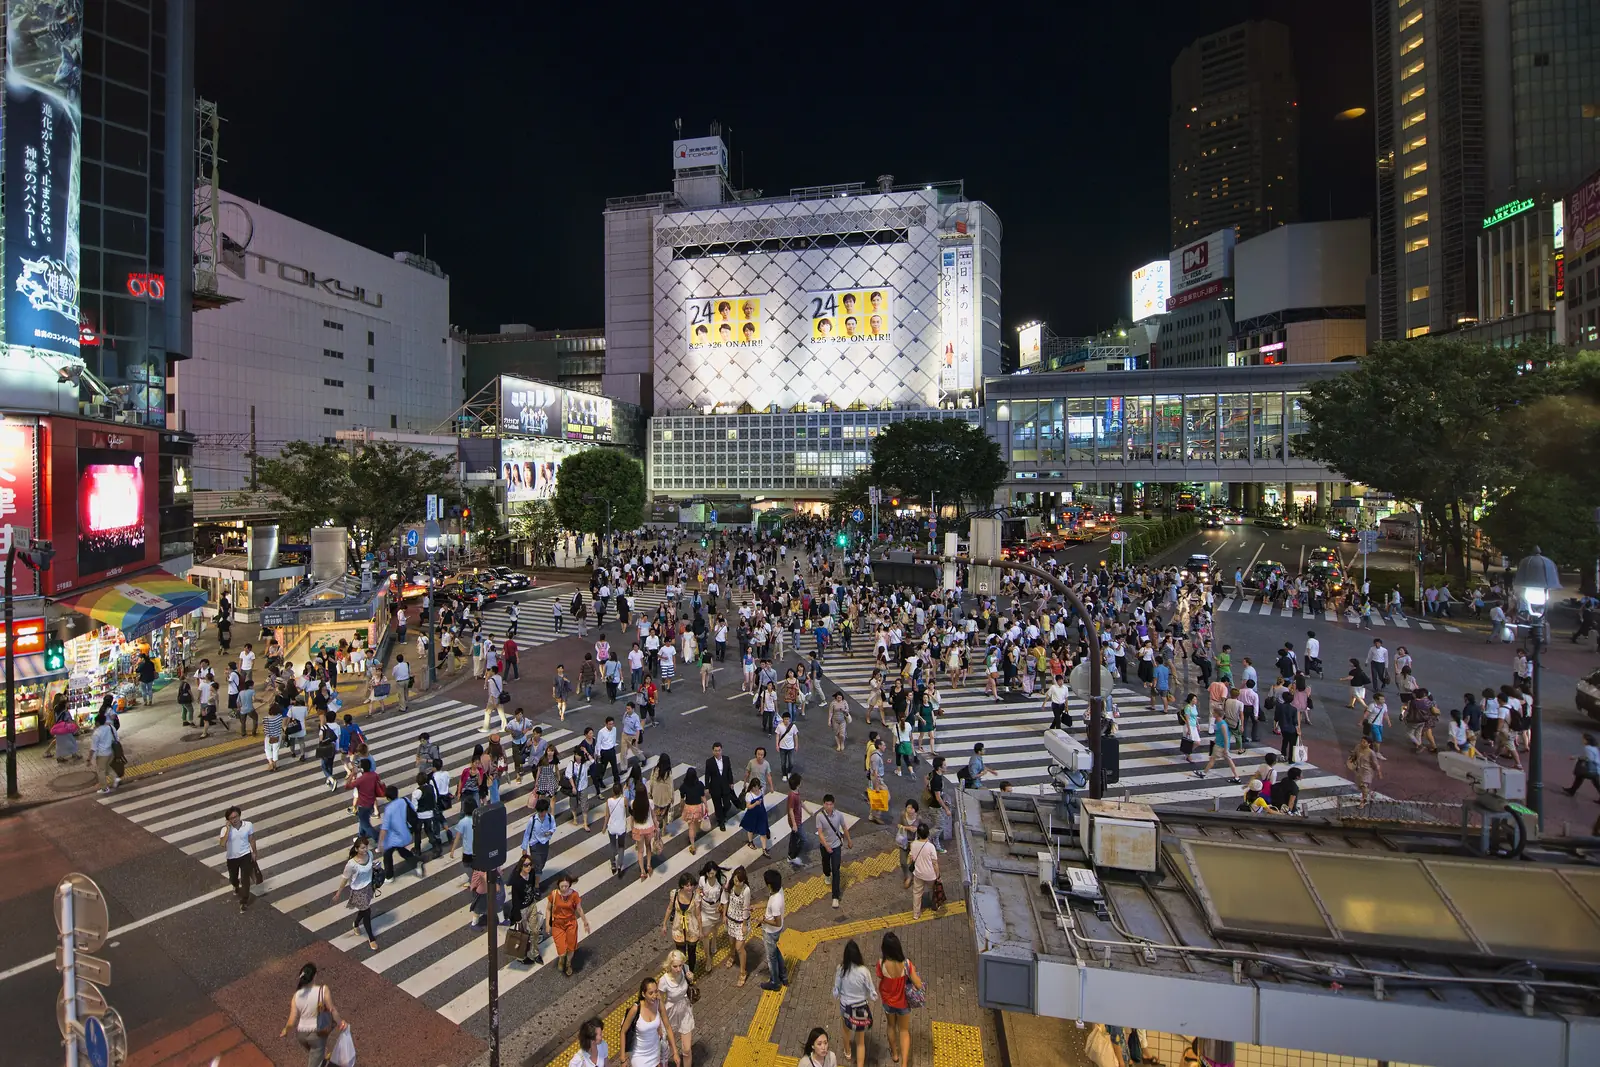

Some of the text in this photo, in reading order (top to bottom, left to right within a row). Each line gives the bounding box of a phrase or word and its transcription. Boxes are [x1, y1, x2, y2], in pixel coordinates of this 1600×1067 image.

[41, 103, 53, 243] 進化がもう、止まらない。
[24, 146, 38, 247] 神撃のバハムート。
[1495, 199, 1520, 214] SHIBUYA
[1483, 198, 1533, 226] MARK CITY
[246, 251, 383, 308] TOKYU
[1156, 265, 1165, 308] SNKYO
[690, 300, 716, 325] 24
[811, 293, 839, 319] 24
[850, 335, 862, 343] ON
[863, 333, 891, 342] AIR!!
